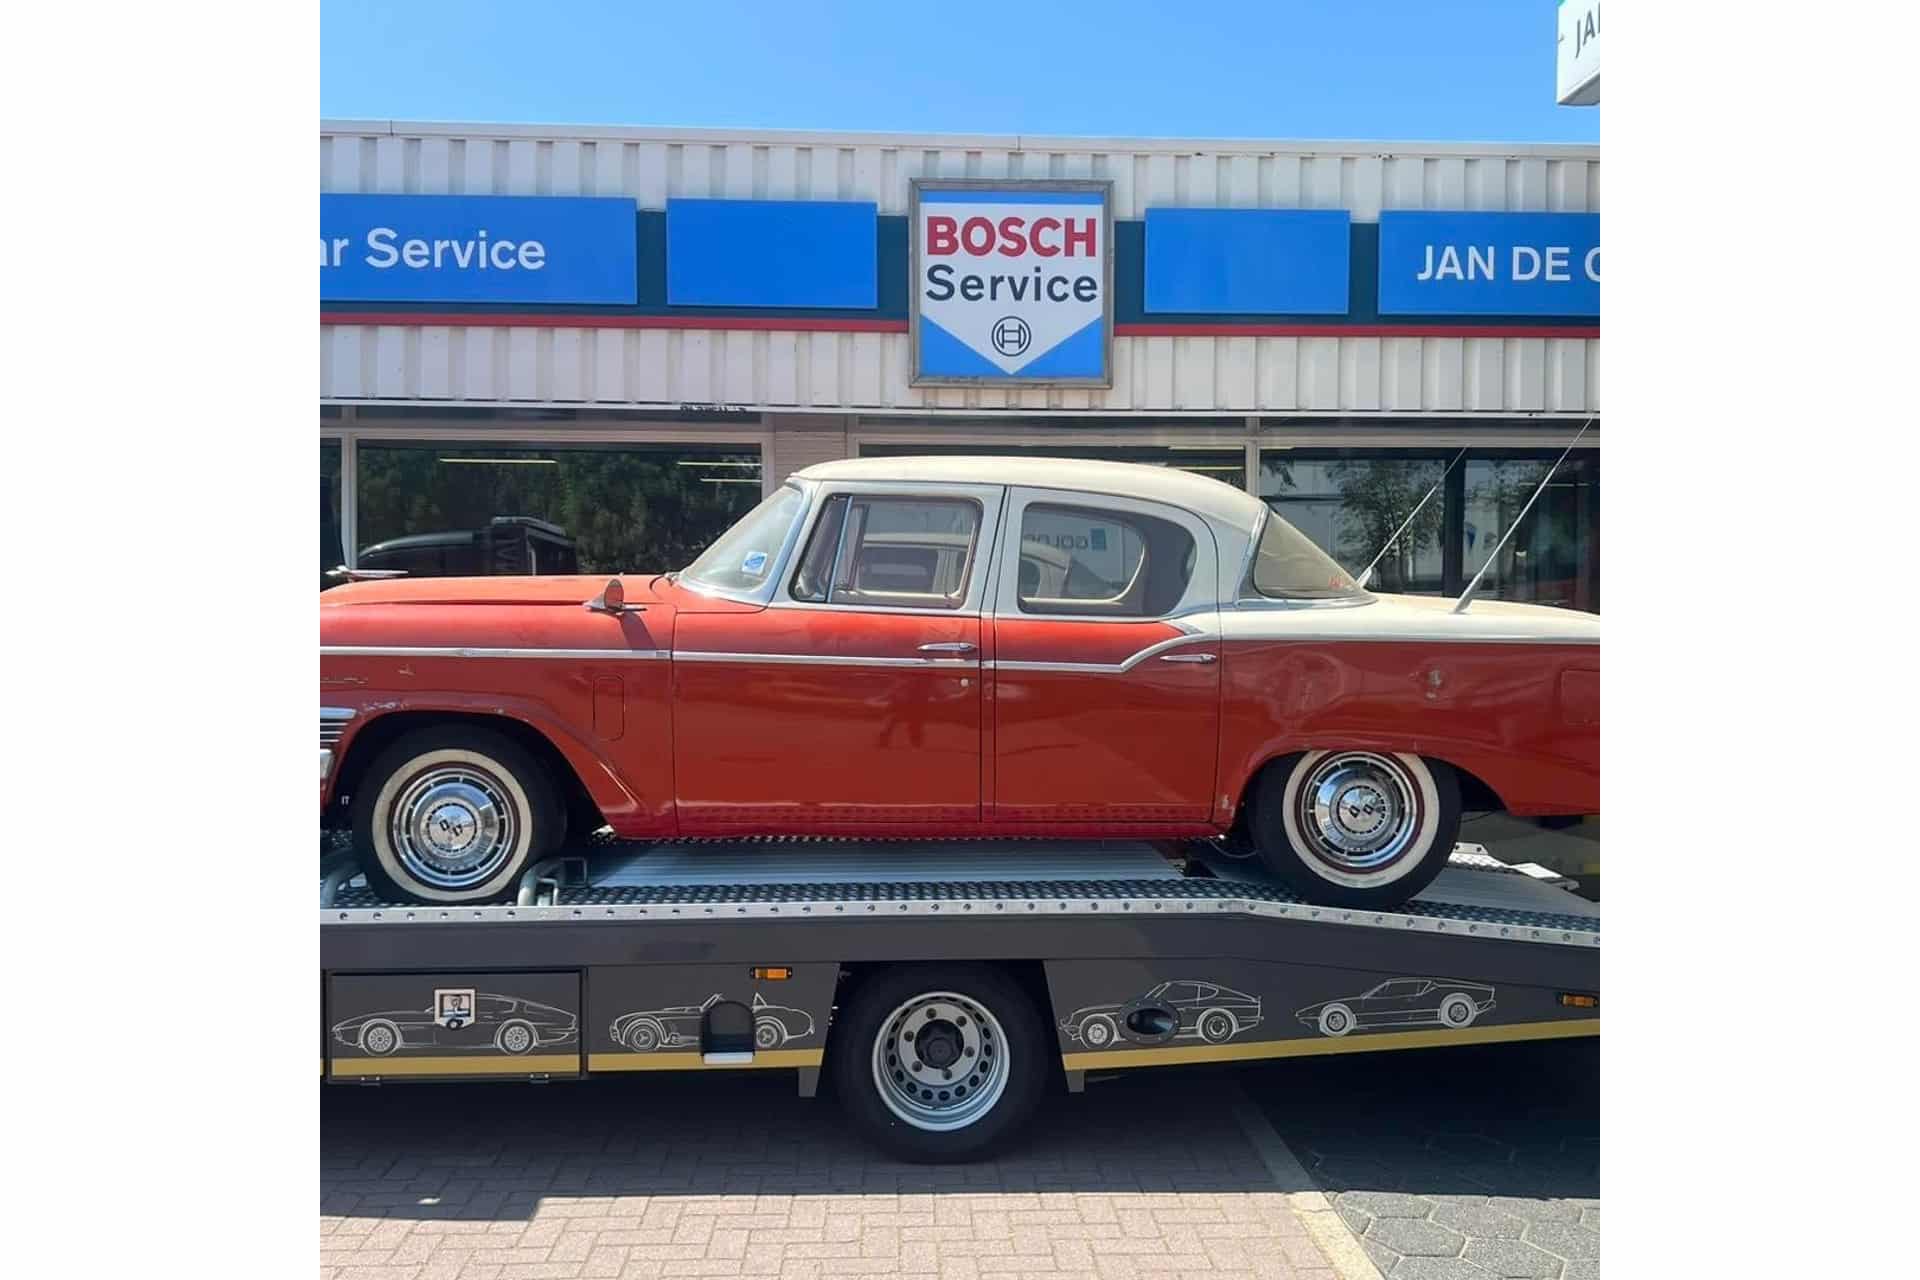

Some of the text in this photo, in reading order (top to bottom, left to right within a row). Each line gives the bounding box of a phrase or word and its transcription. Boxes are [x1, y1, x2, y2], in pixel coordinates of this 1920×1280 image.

[1575, 2, 1600, 59] JA
[365, 227, 546, 270] Service
[926, 216, 1097, 257] BOSCH
[925, 263, 1098, 303] Service
[1417, 245, 1495, 282] JAN
[1512, 246, 1571, 282] DE
